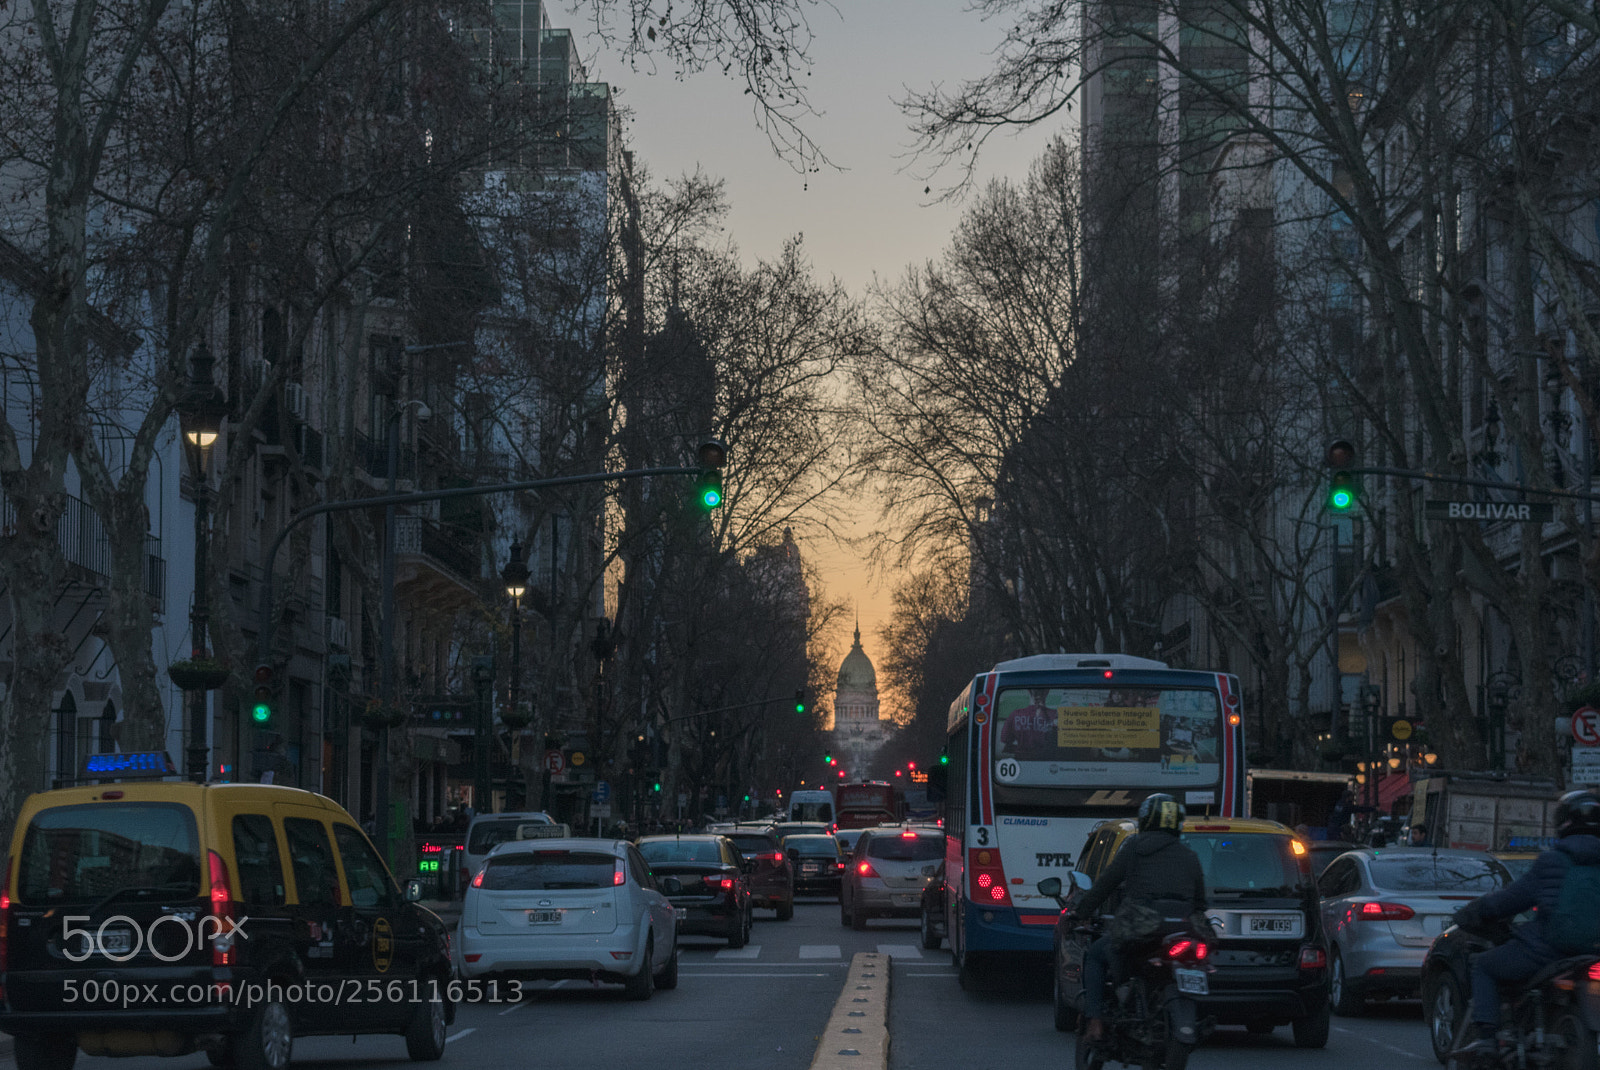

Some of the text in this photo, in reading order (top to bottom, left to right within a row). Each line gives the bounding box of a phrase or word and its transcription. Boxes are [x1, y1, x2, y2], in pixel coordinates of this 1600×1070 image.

[1448, 502, 1530, 519] BOLIVAR
[1123, 710, 1152, 719] Integral
[1076, 719, 1115, 727] Seguridad
[1000, 763, 1016, 777] 60
[1003, 818, 1048, 826] CLIMABUS
[977, 827, 989, 846] 3
[1036, 853, 1074, 867] TPTE.
